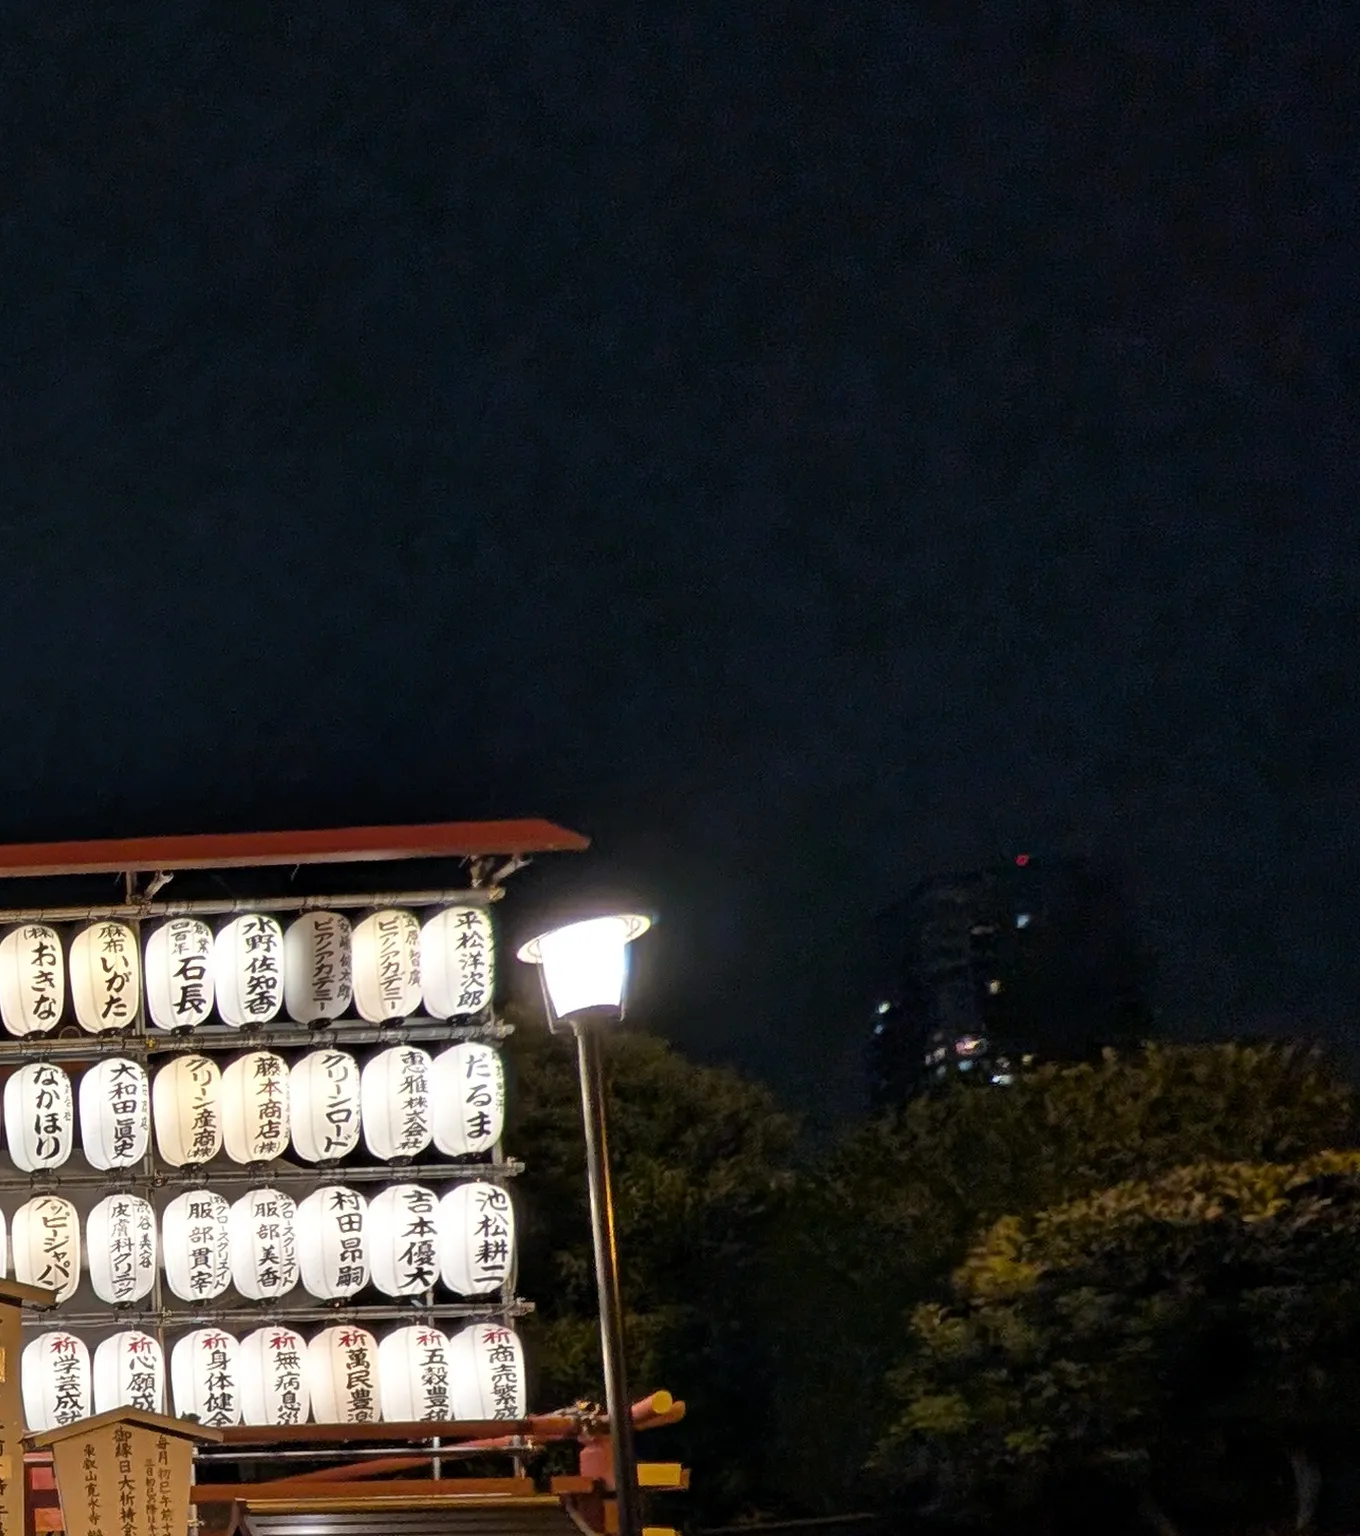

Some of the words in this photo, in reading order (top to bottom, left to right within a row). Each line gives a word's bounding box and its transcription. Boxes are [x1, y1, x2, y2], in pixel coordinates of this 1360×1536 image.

[173, 955, 207, 1016] 石長
[242, 917, 278, 1014] 水野佐知香
[312, 916, 336, 1011] ピアノアカデミー
[378, 915, 402, 1010] ピアノアカデミー
[454, 911, 485, 1008] 平松洋次郎
[33, 1066, 62, 1160] なかほり
[321, 1054, 352, 1153] クリーンロード
[465, 1051, 492, 1139] だるま
[254, 1201, 281, 1288] 服部美香
